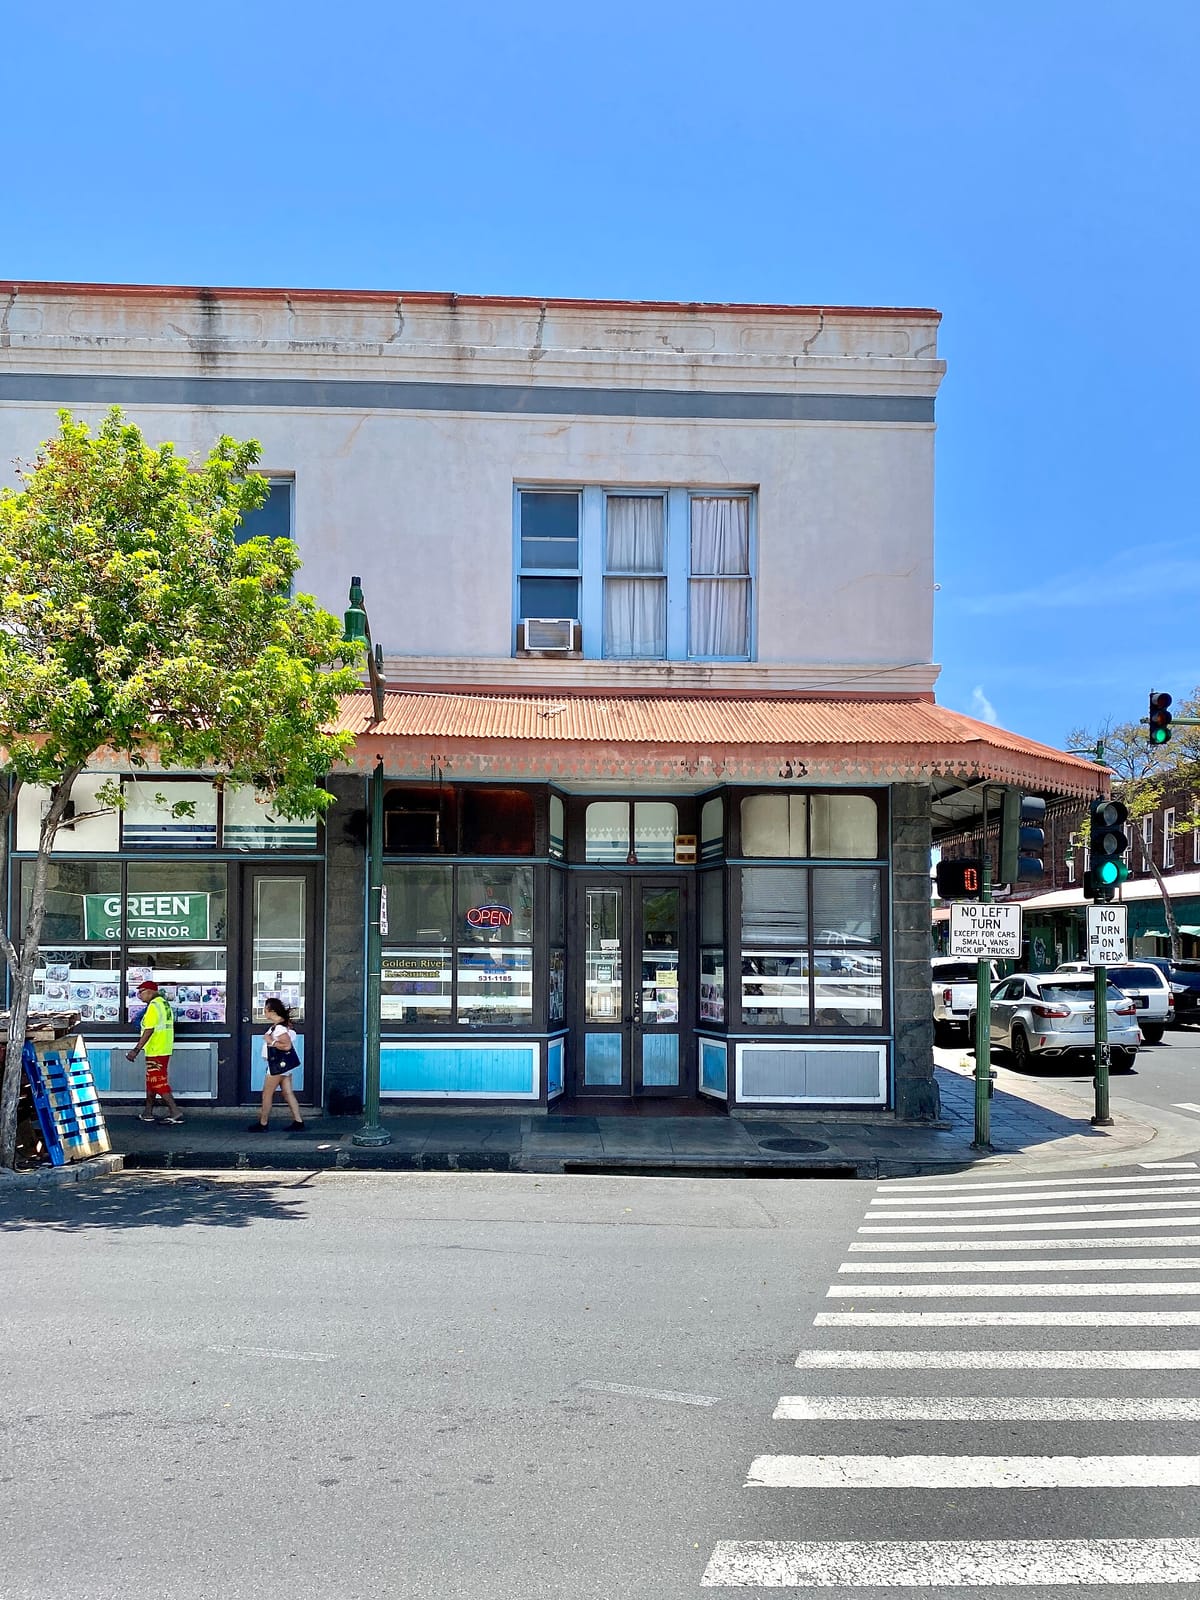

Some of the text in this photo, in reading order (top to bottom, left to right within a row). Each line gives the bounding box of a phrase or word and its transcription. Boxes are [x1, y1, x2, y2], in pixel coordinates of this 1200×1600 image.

[104, 896, 190, 917] GREEN
[467, 908, 511, 926] OPEN
[961, 907, 1010, 918] NO LEFT
[1101, 911, 1116, 922] NO
[971, 919, 1001, 929] TURN
[1095, 926, 1120, 935] TURN
[1102, 938, 1114, 948] ON
[1100, 952, 1117, 961] RED
[382, 959, 447, 968] Golden River
[384, 970, 441, 978] Restaurant
